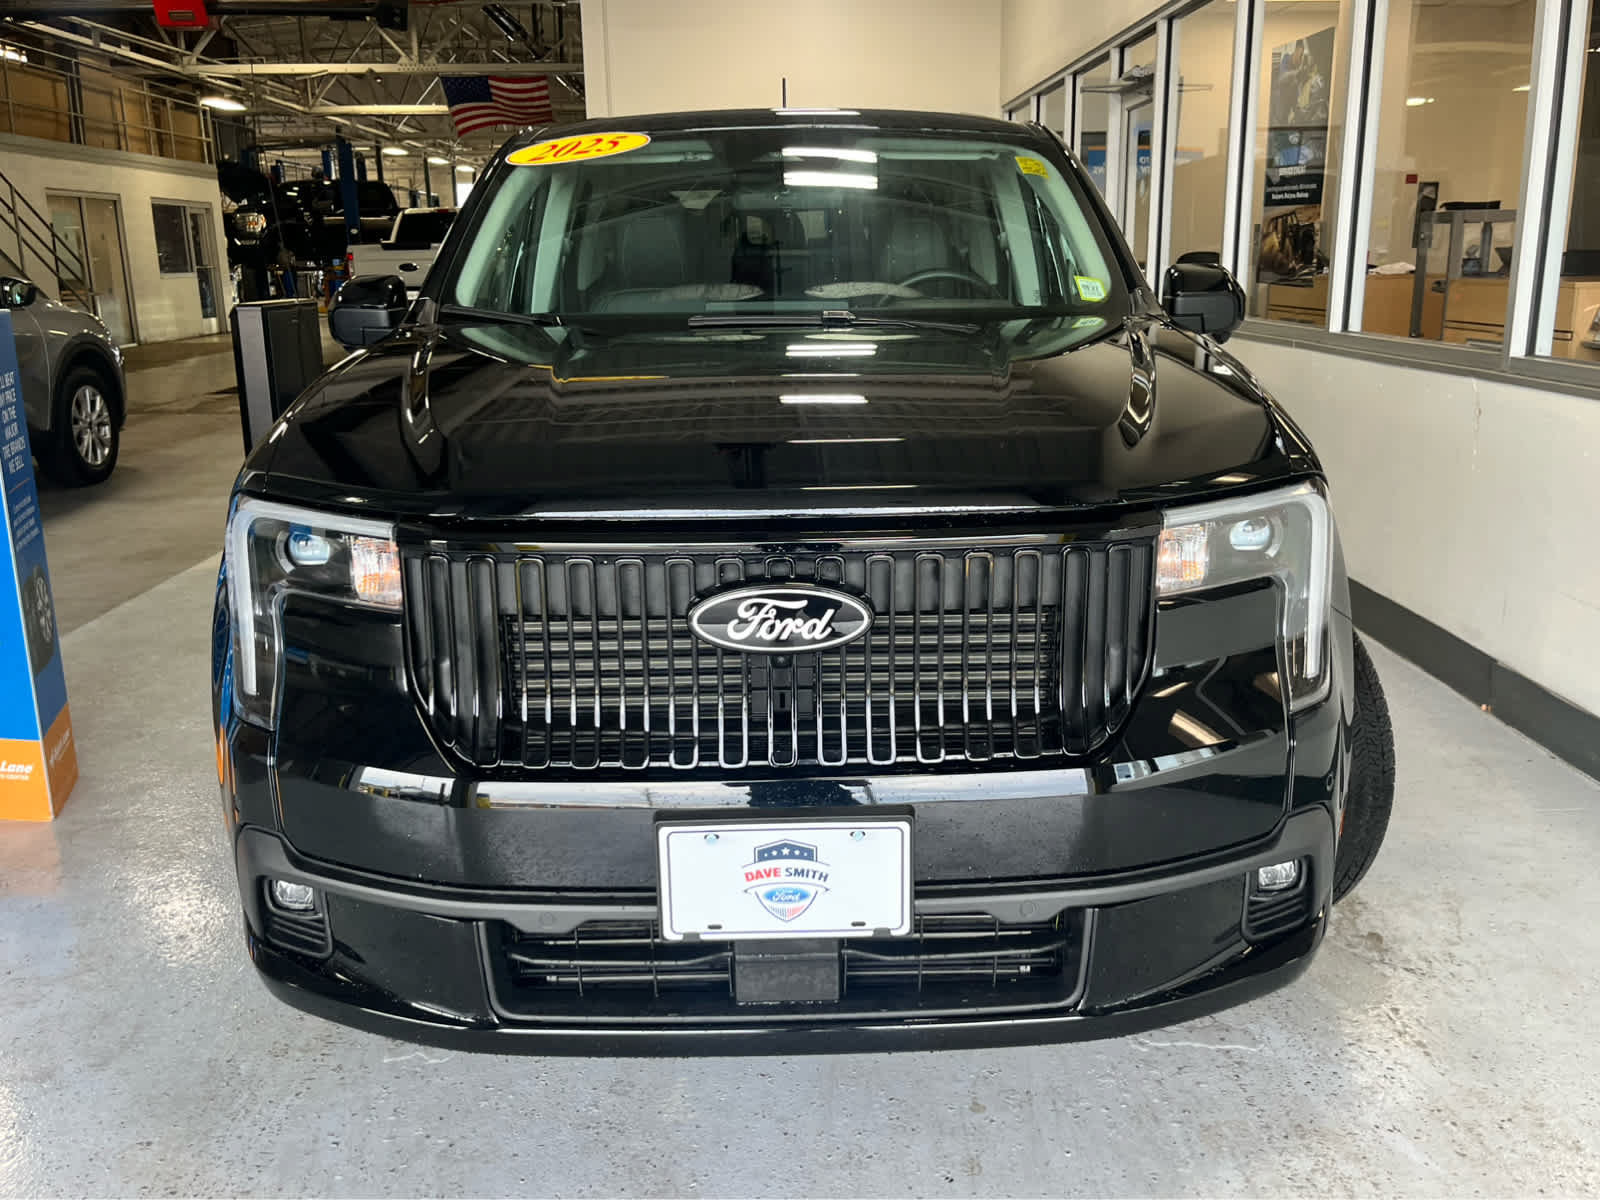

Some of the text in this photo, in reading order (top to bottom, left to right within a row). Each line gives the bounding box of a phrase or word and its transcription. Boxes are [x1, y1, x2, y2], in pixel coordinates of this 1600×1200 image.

[528, 136, 628, 162] 2025
[727, 598, 836, 640] Ford
[0, 760, 33, 774] Lane
[744, 867, 829, 882] DAVE SMITH
[772, 887, 801, 903] Ford
